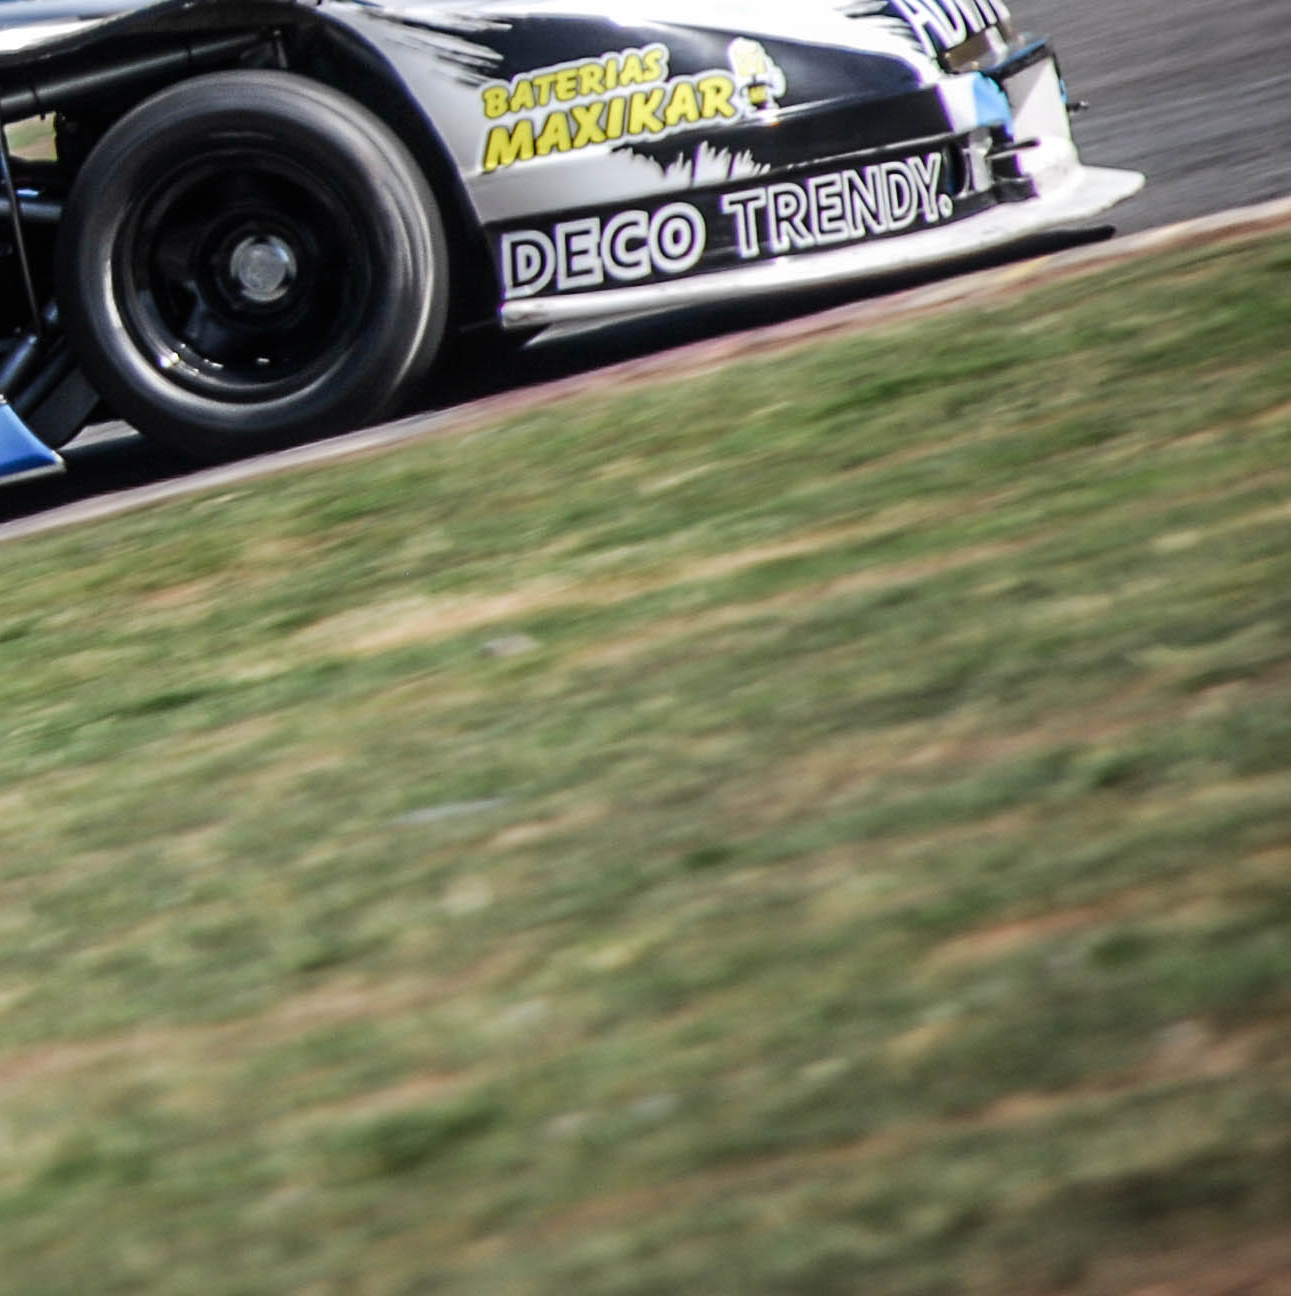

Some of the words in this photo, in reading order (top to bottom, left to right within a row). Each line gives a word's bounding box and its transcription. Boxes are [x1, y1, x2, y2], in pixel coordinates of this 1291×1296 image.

[482, 49, 663, 118] BATERIAS
[484, 76, 736, 172] MAXIKAR
[503, 202, 706, 298] DECO
